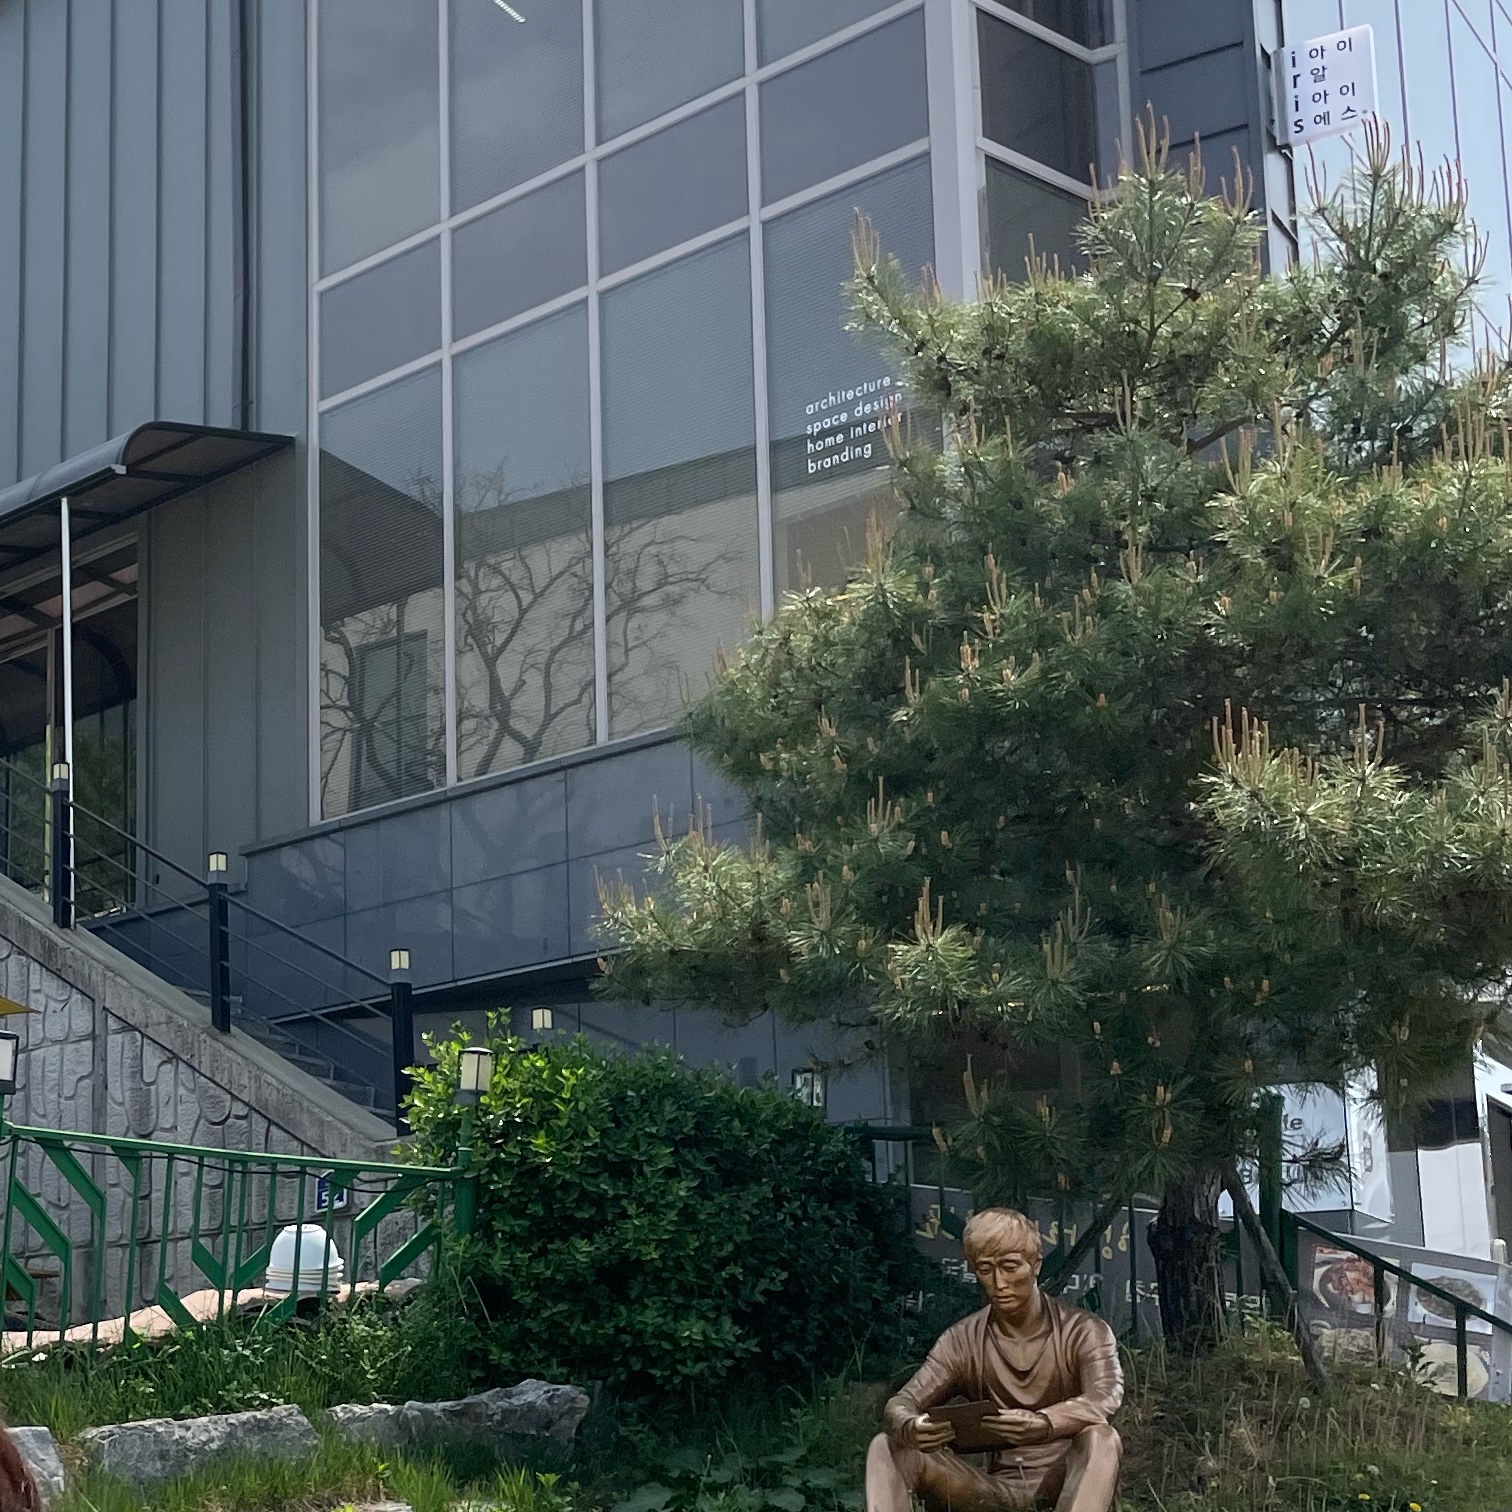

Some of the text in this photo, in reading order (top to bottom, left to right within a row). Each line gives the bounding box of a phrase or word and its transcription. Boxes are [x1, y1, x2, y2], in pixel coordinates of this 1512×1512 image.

[805, 376, 891, 415] architecture
[805, 412, 848, 436] space
[806, 433, 844, 454] home
[807, 443, 872, 474] branding
